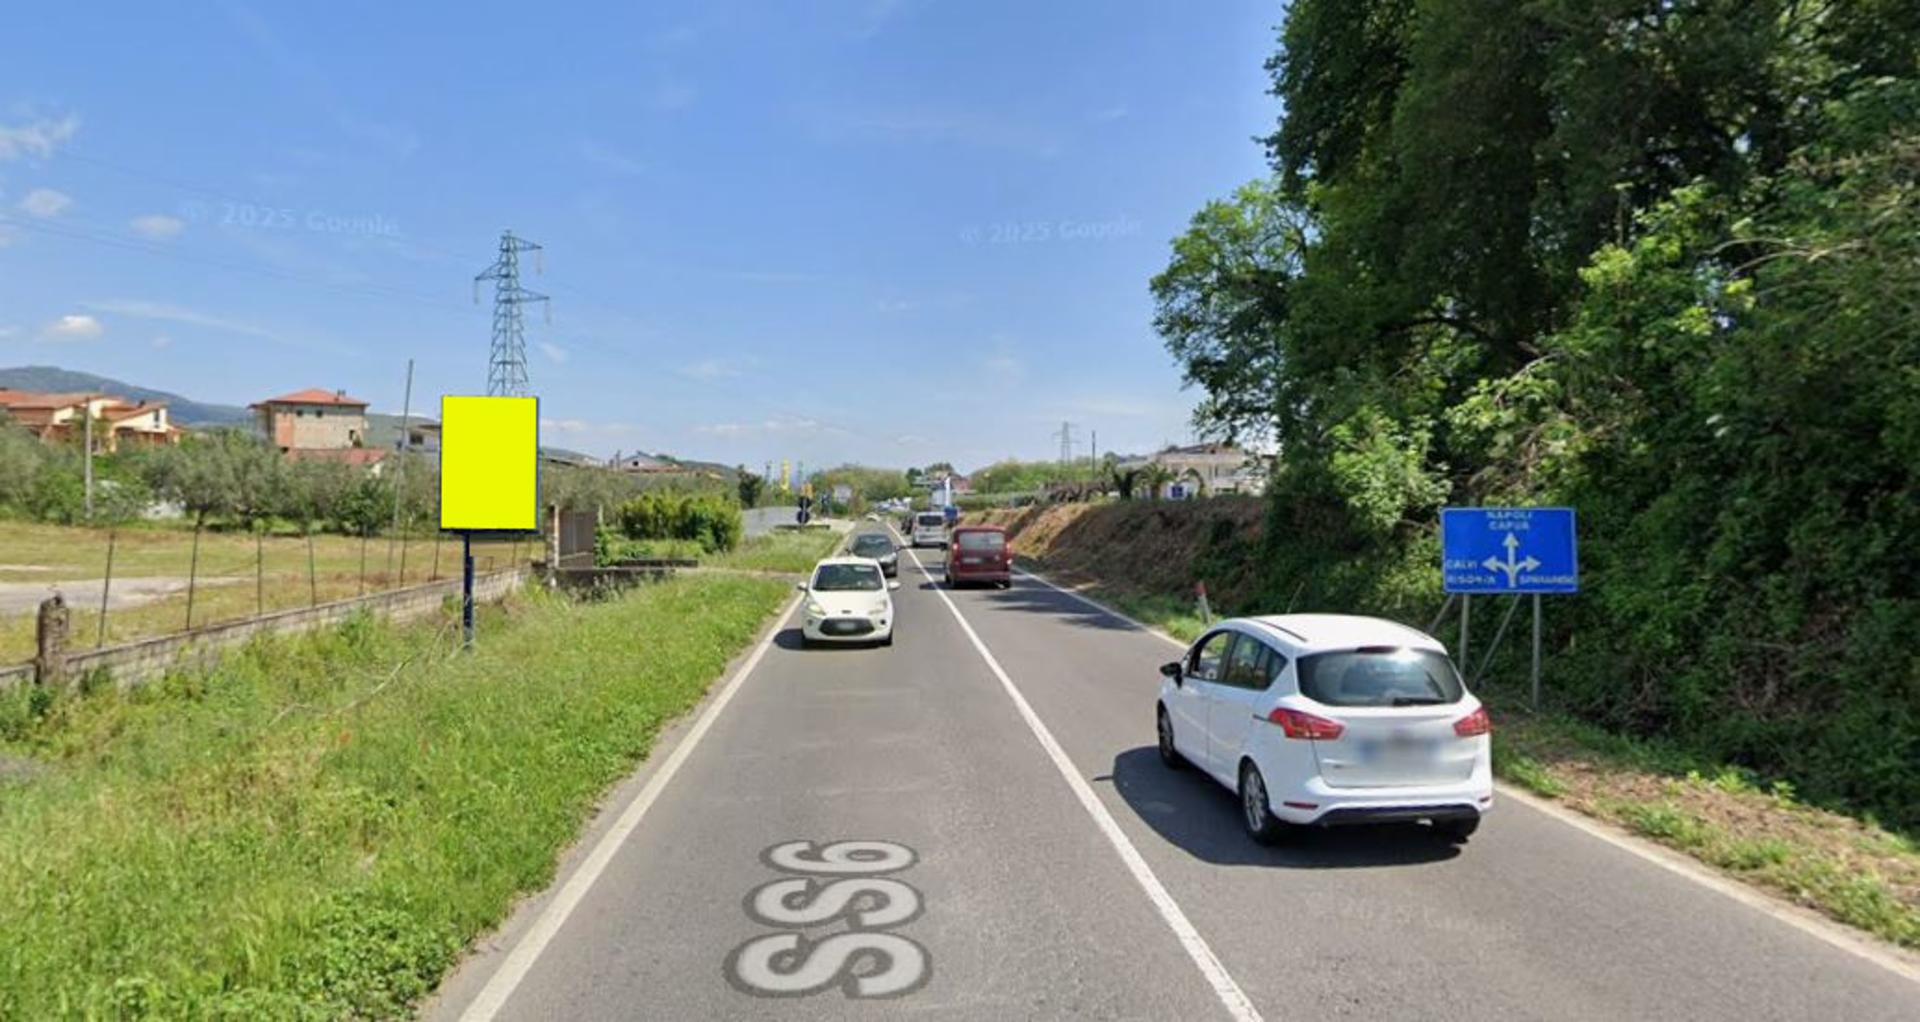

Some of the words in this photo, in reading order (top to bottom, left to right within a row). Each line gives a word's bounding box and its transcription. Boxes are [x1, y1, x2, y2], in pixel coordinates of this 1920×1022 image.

[1486, 511, 1532, 519] NAPOLI
[1488, 520, 1530, 530] CAPUA
[1446, 559, 1478, 569] CALVI
